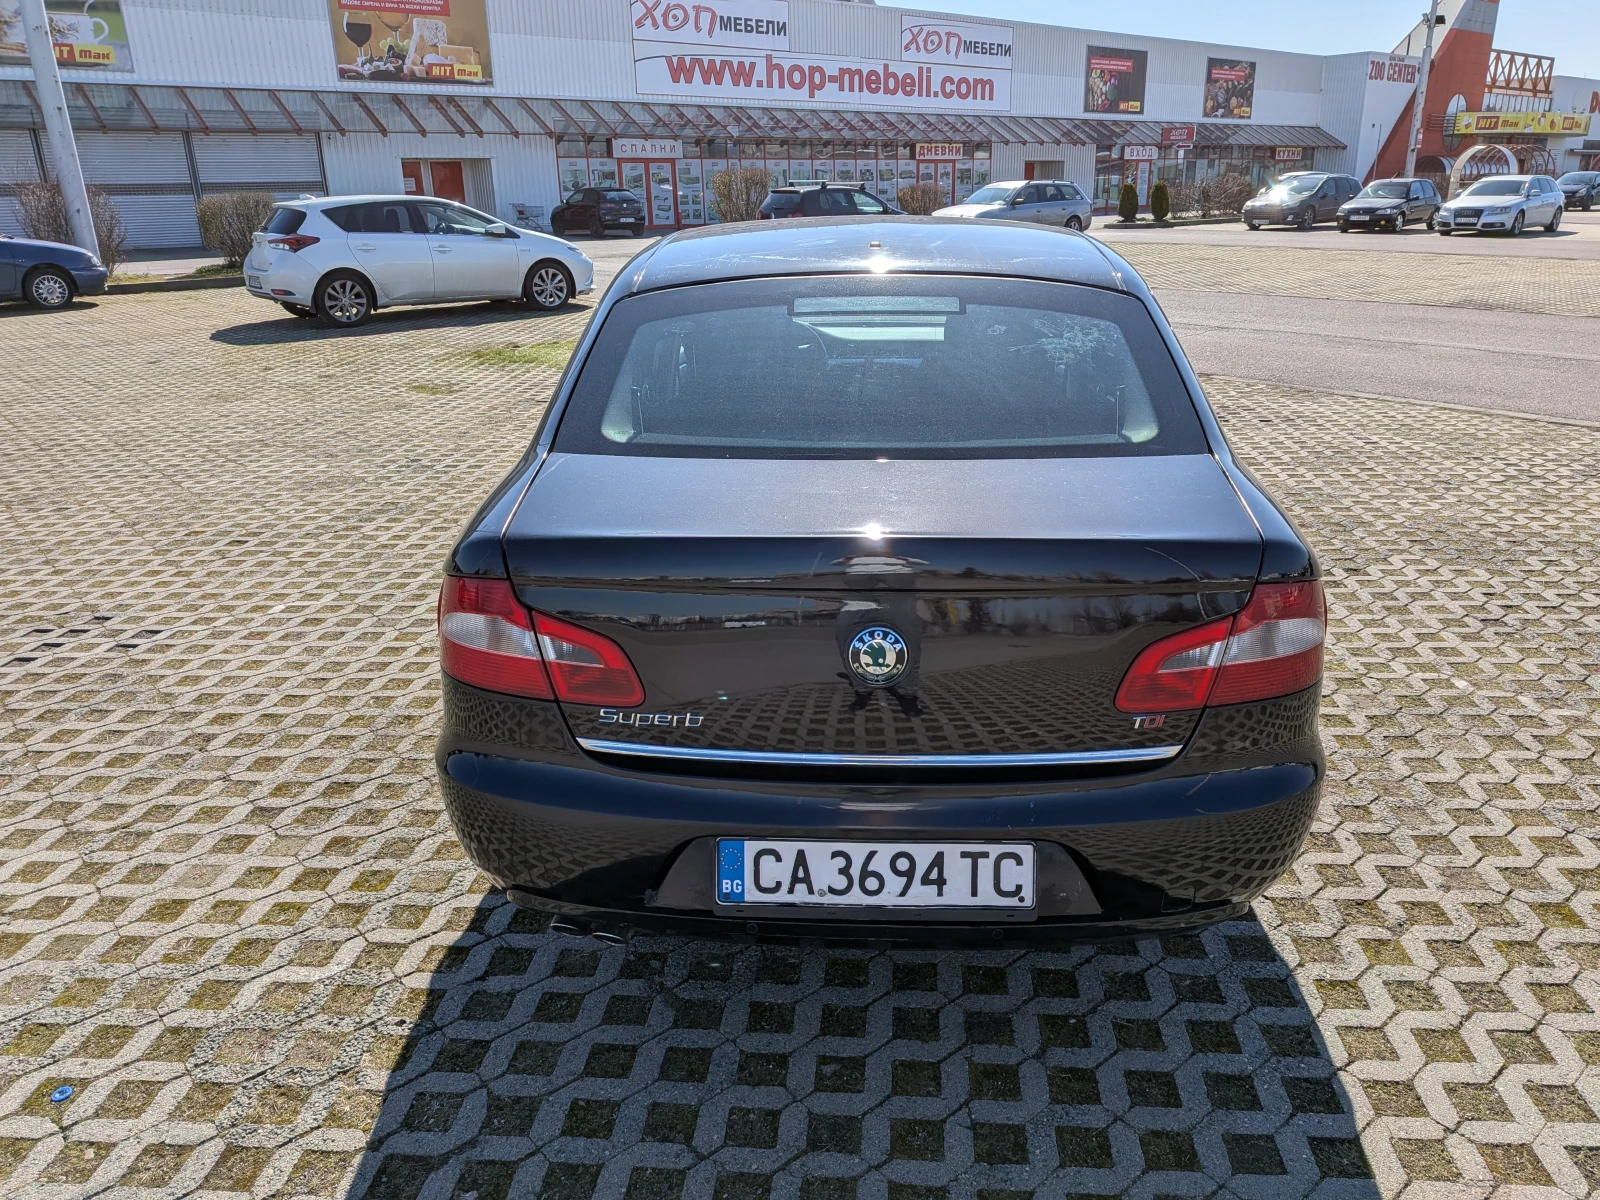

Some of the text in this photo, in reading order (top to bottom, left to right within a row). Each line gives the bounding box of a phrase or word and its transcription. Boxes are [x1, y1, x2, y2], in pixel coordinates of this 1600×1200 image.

[719, 15, 787, 37] МЕБЕЛИ
[79, 49, 111, 60] Max
[963, 39, 1012, 58] МЕБЕЛИ
[432, 65, 479, 78] HIT Max
[664, 53, 995, 101] www.hop-mebeli.com
[1369, 59, 1417, 84] ZOO CENTER
[1477, 117, 1519, 128] HIT Max
[620, 143, 676, 154] СПАЛНИ
[918, 145, 961, 158] ДНЕВНИ
[1129, 147, 1153, 158] ВХОД
[599, 708, 704, 727] Superb
[1132, 714, 1166, 729] TDI
[753, 848, 1024, 898] CA 3694 TC
[722, 879, 743, 893] BG
